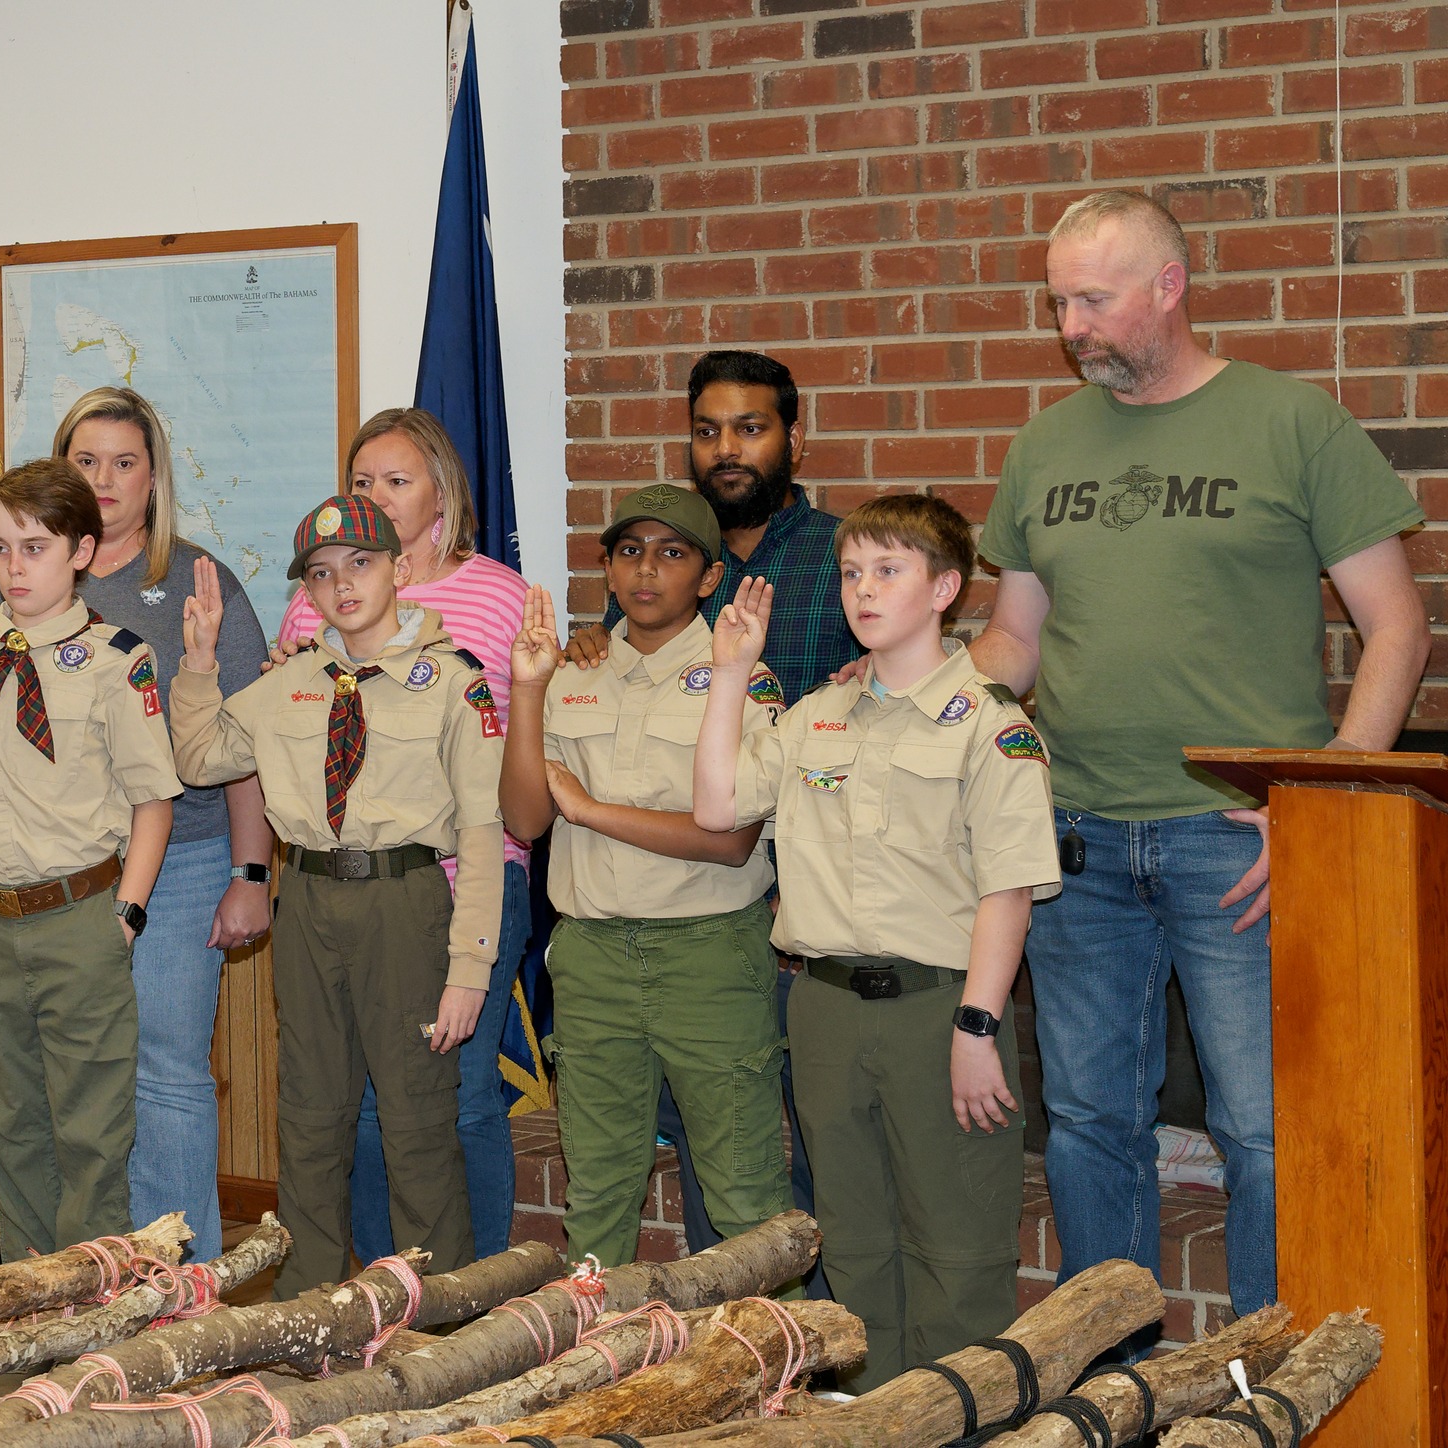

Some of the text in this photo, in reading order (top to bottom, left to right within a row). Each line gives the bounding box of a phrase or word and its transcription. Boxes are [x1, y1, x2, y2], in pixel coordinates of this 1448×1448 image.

[203, 292, 261, 303] COMMONWEALTH
[269, 291, 282, 299] The
[283, 289, 318, 298] BAHAMAS
[168, 335, 188, 362] NORTH
[195, 374, 223, 410] ATLANTIC
[230, 422, 251, 448] OCEAN
[1043, 476, 1238, 526] US MC
[303, 693, 325, 702] BSA
[575, 695, 598, 705] BSA
[825, 722, 848, 732] BSA
